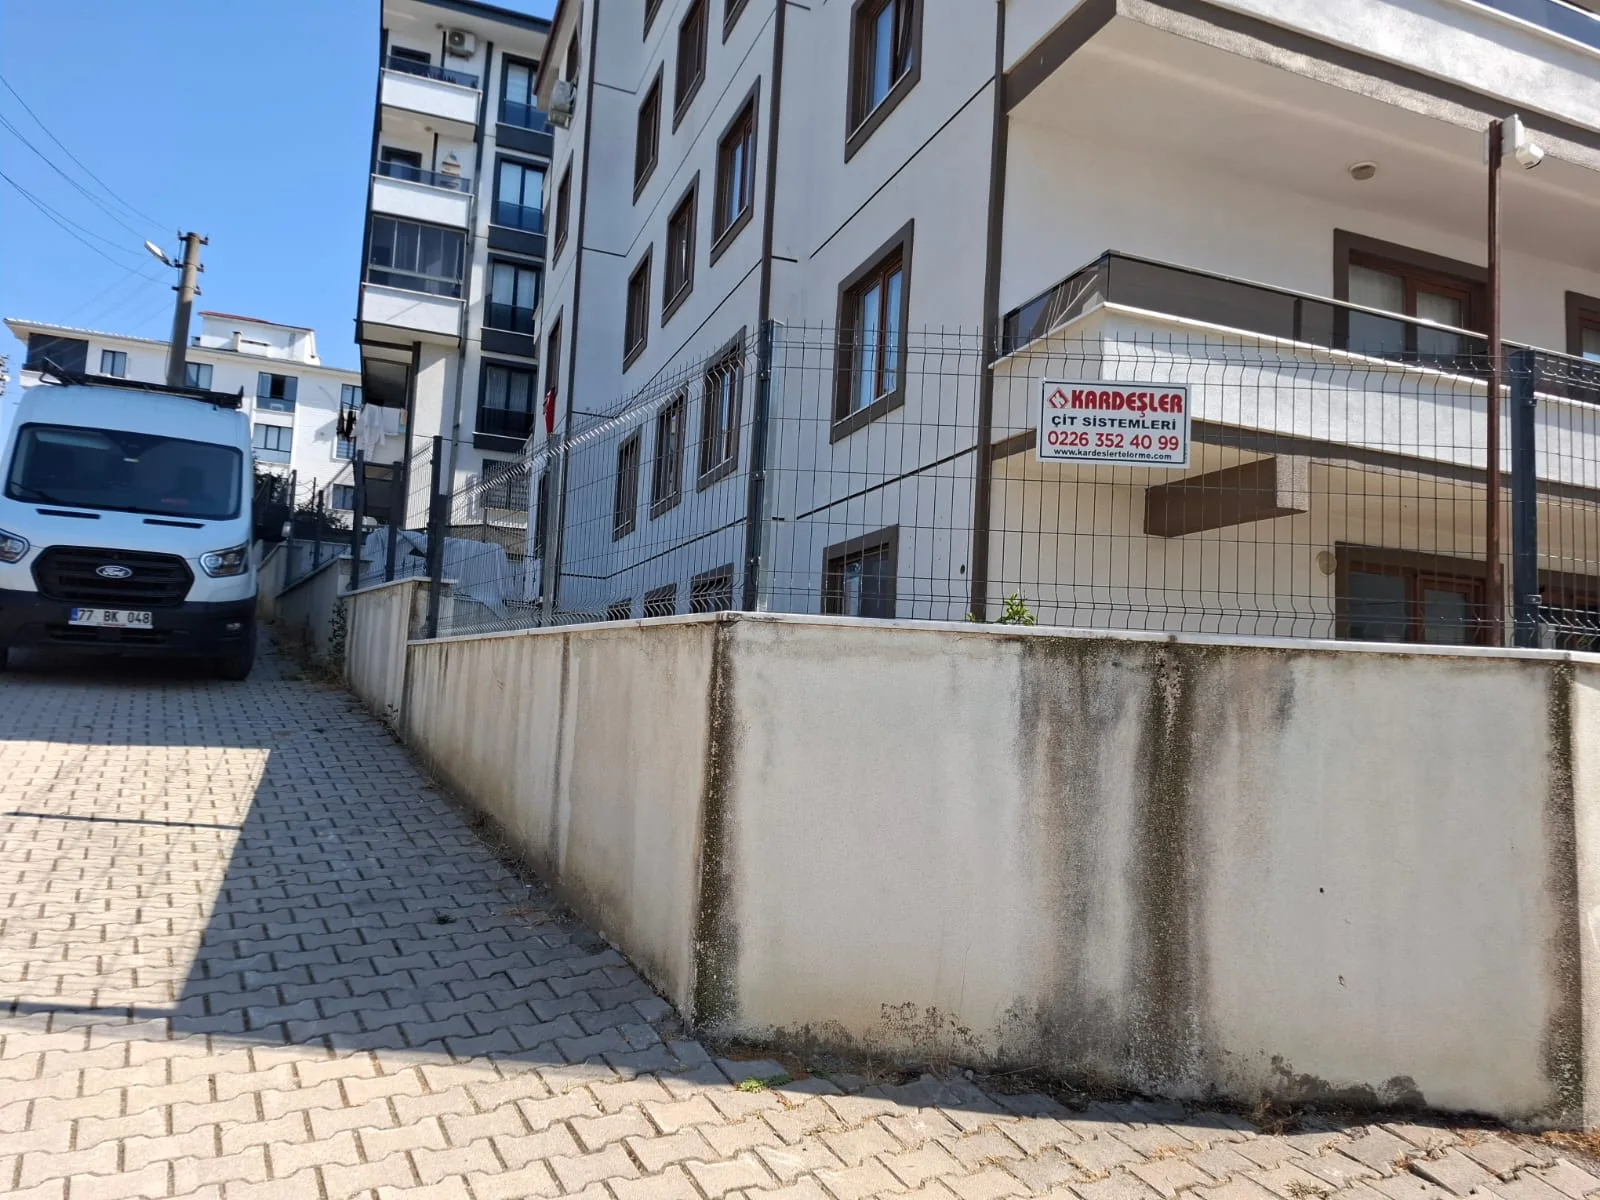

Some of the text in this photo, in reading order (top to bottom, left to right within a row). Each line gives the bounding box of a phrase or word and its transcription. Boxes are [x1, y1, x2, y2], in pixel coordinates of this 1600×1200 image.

[1071, 389, 1183, 418] KARDEŞLER
[1051, 413, 1176, 431] ÇİT SİSTEMLERİ
[1047, 430, 1179, 451] 0226 352 40 99
[79, 609, 94, 621] 77
[103, 610, 119, 622] BK
[127, 611, 150, 624] 048
